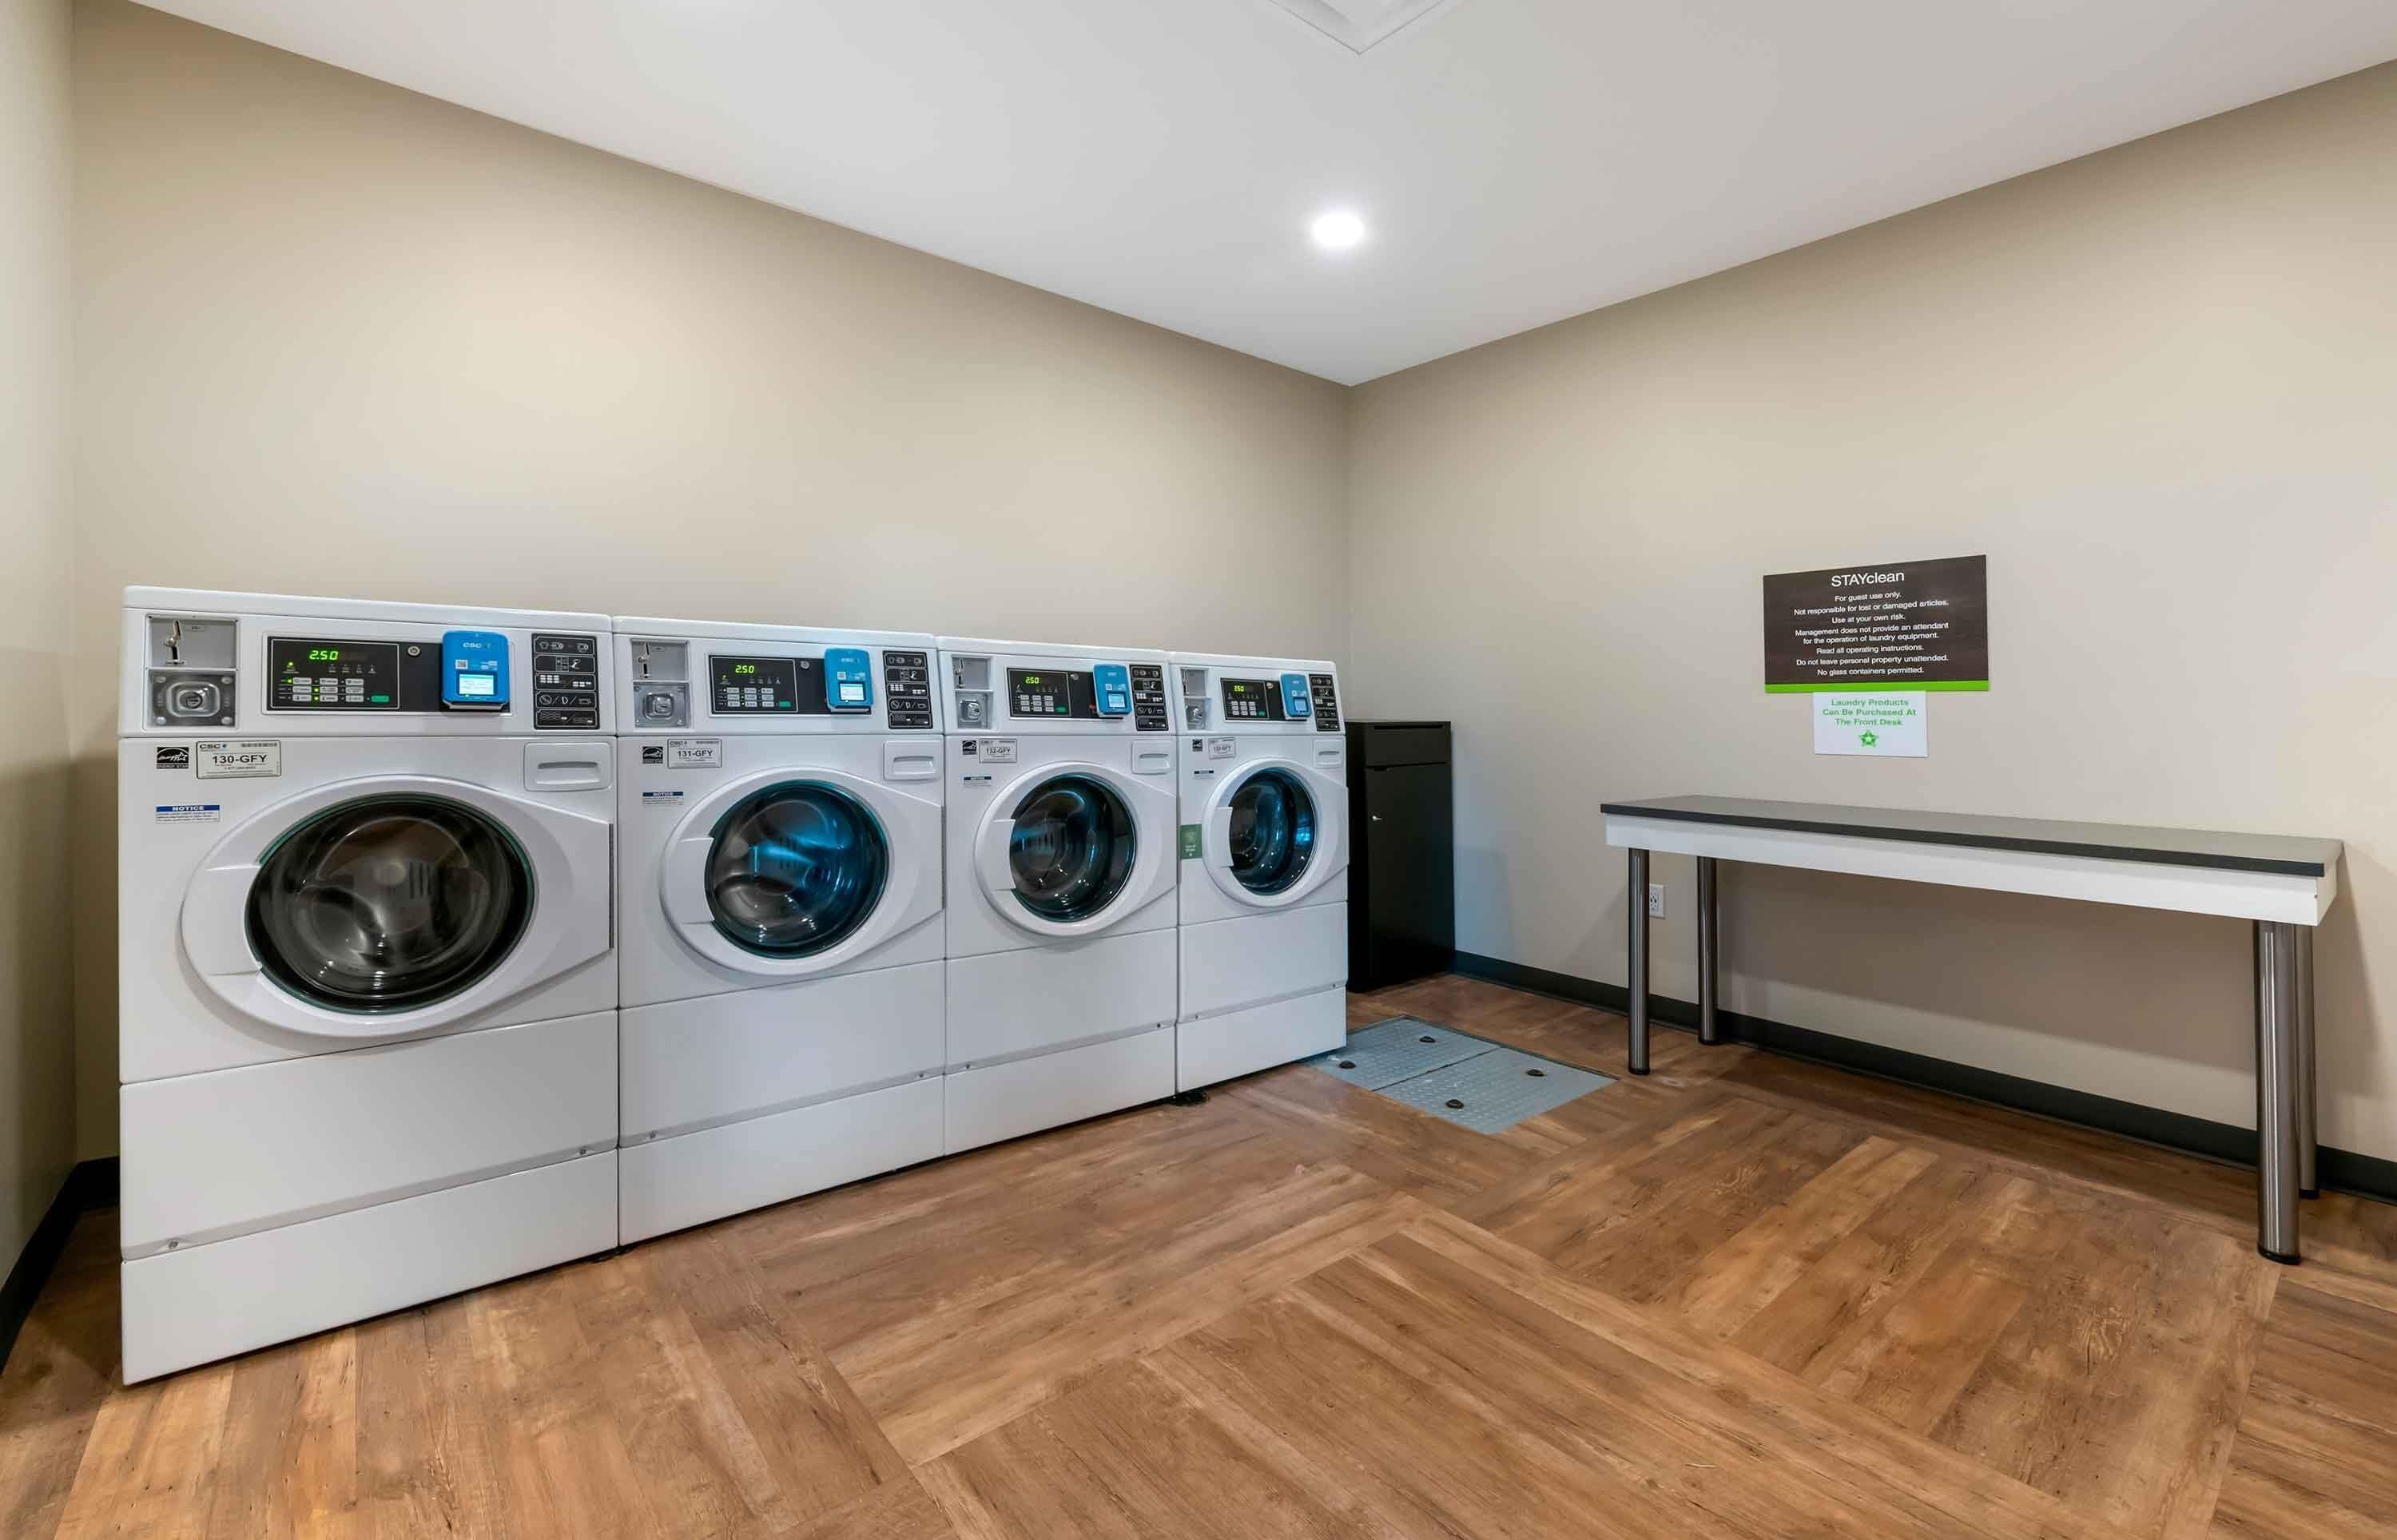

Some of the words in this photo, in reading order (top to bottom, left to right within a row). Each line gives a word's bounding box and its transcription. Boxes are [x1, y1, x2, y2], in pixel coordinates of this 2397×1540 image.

[1831, 572, 1905, 587] STAYclean
[1807, 606, 1846, 616] responsible
[1882, 601, 1918, 609] damaged
[1795, 628, 1838, 637] Management
[1897, 632, 1939, 641] equipment.
[308, 650, 339, 661] 2.50
[1839, 657, 1870, 665] personal
[1887, 666, 1925, 675] permitted.
[212, 754, 268, 764] 130-GFY
